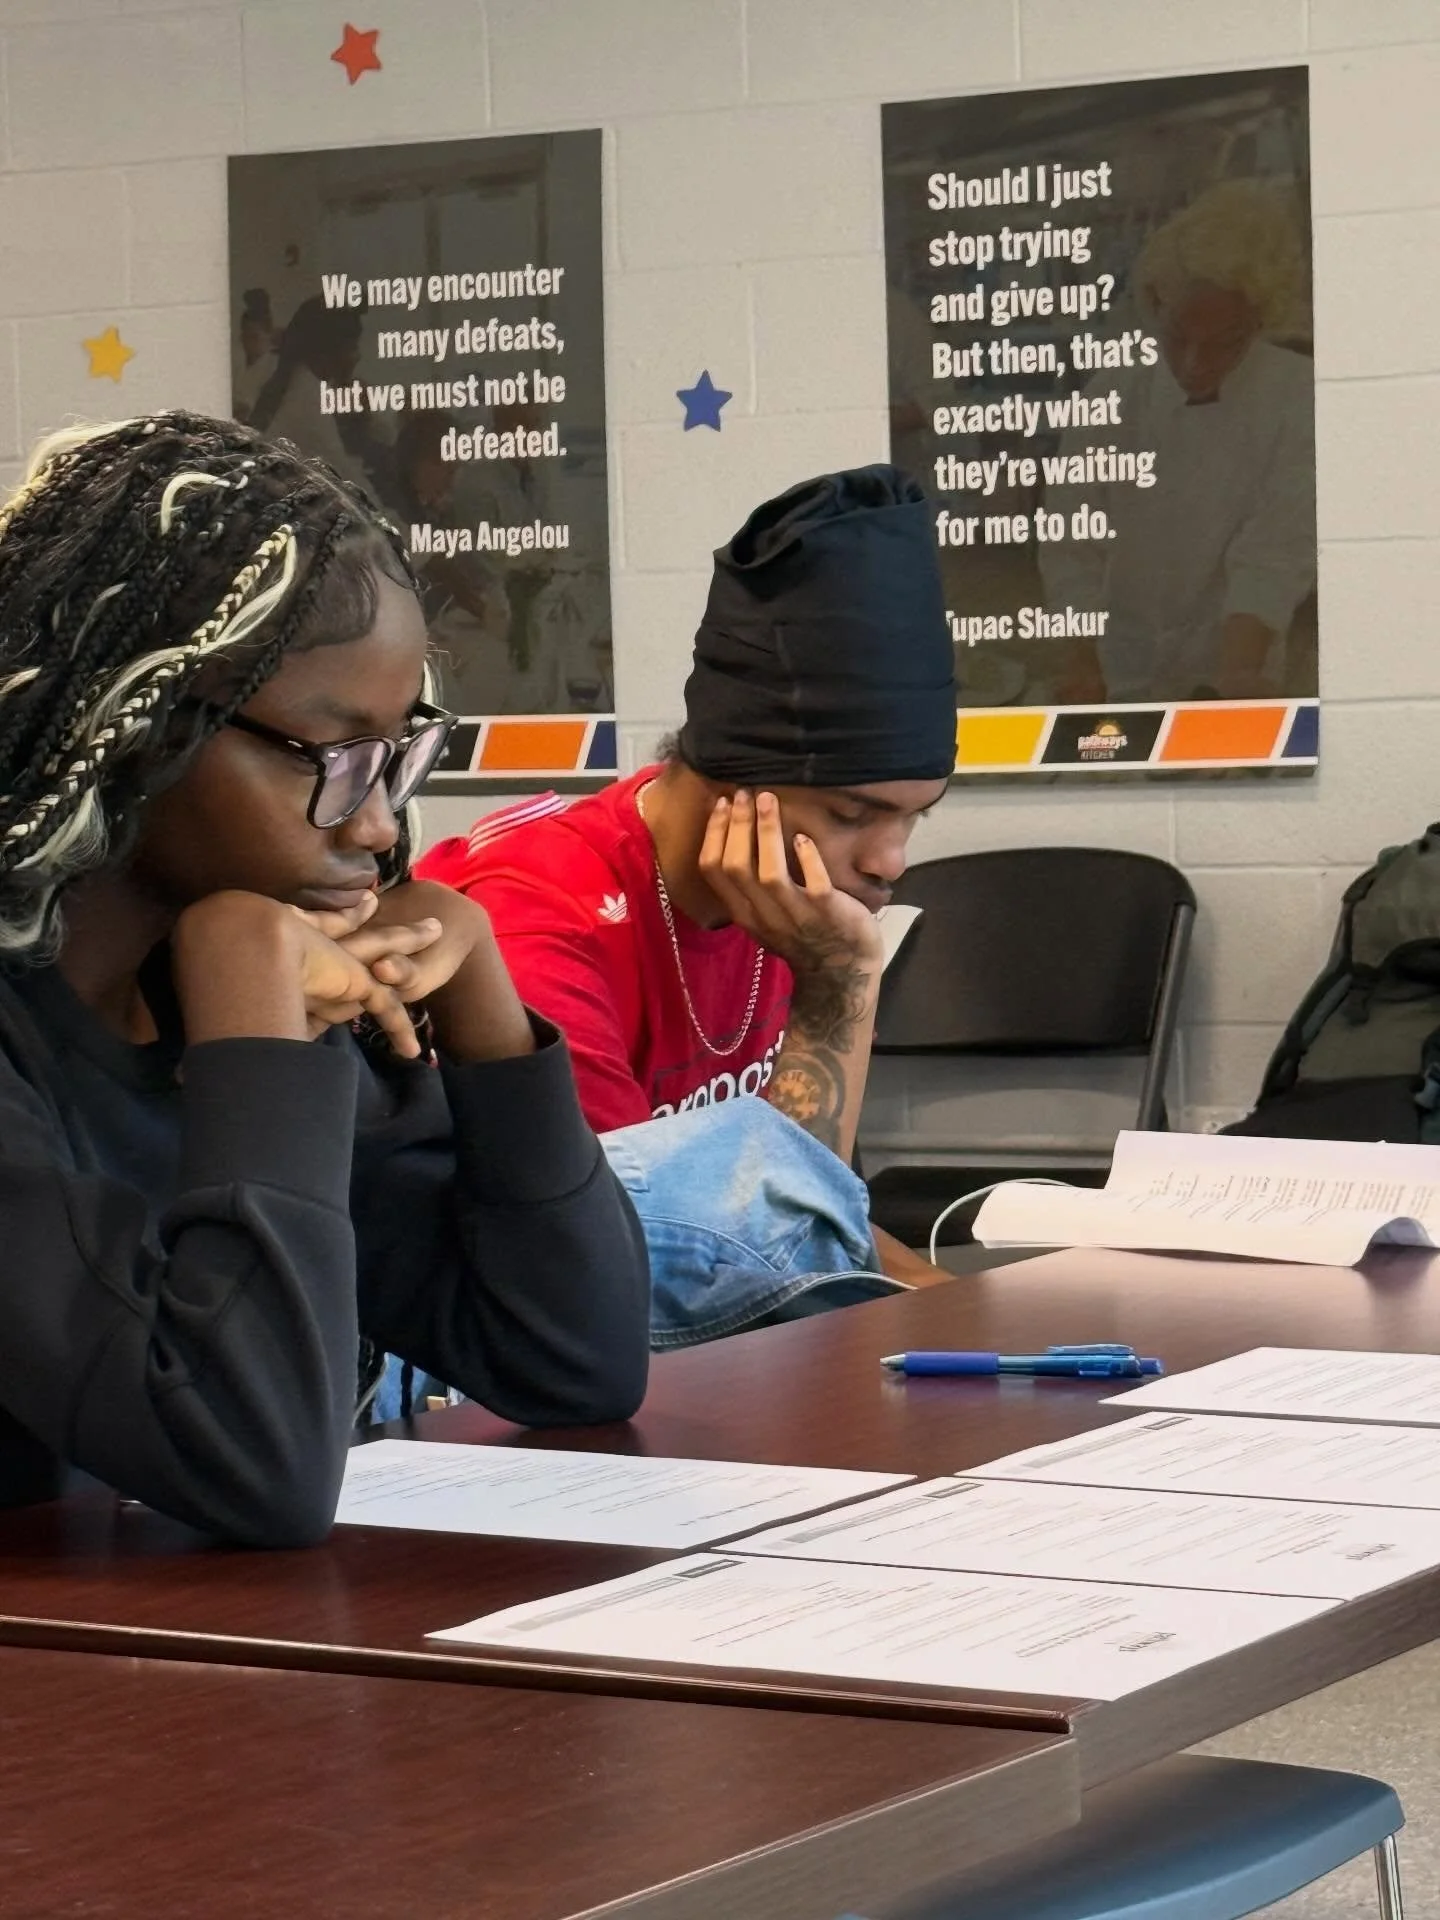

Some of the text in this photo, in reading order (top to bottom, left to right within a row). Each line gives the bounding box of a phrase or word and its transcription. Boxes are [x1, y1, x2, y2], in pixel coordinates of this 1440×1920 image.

[927, 161, 1113, 211] Should I just
[928, 221, 1092, 271] stop trying
[321, 263, 565, 311] We may encounter
[930, 273, 1115, 327] and give up?
[377, 316, 565, 363] many defeats,
[932, 329, 1159, 379] But then, that's
[320, 368, 566, 415] but we must not be
[933, 389, 1122, 438] exactly what
[440, 421, 568, 462] defeated.
[933, 445, 1158, 496] they're waiting
[410, 519, 570, 561] Maya Angelou
[935, 503, 1117, 547] for me to do.
[1017, 605, 1110, 640] Shakur
